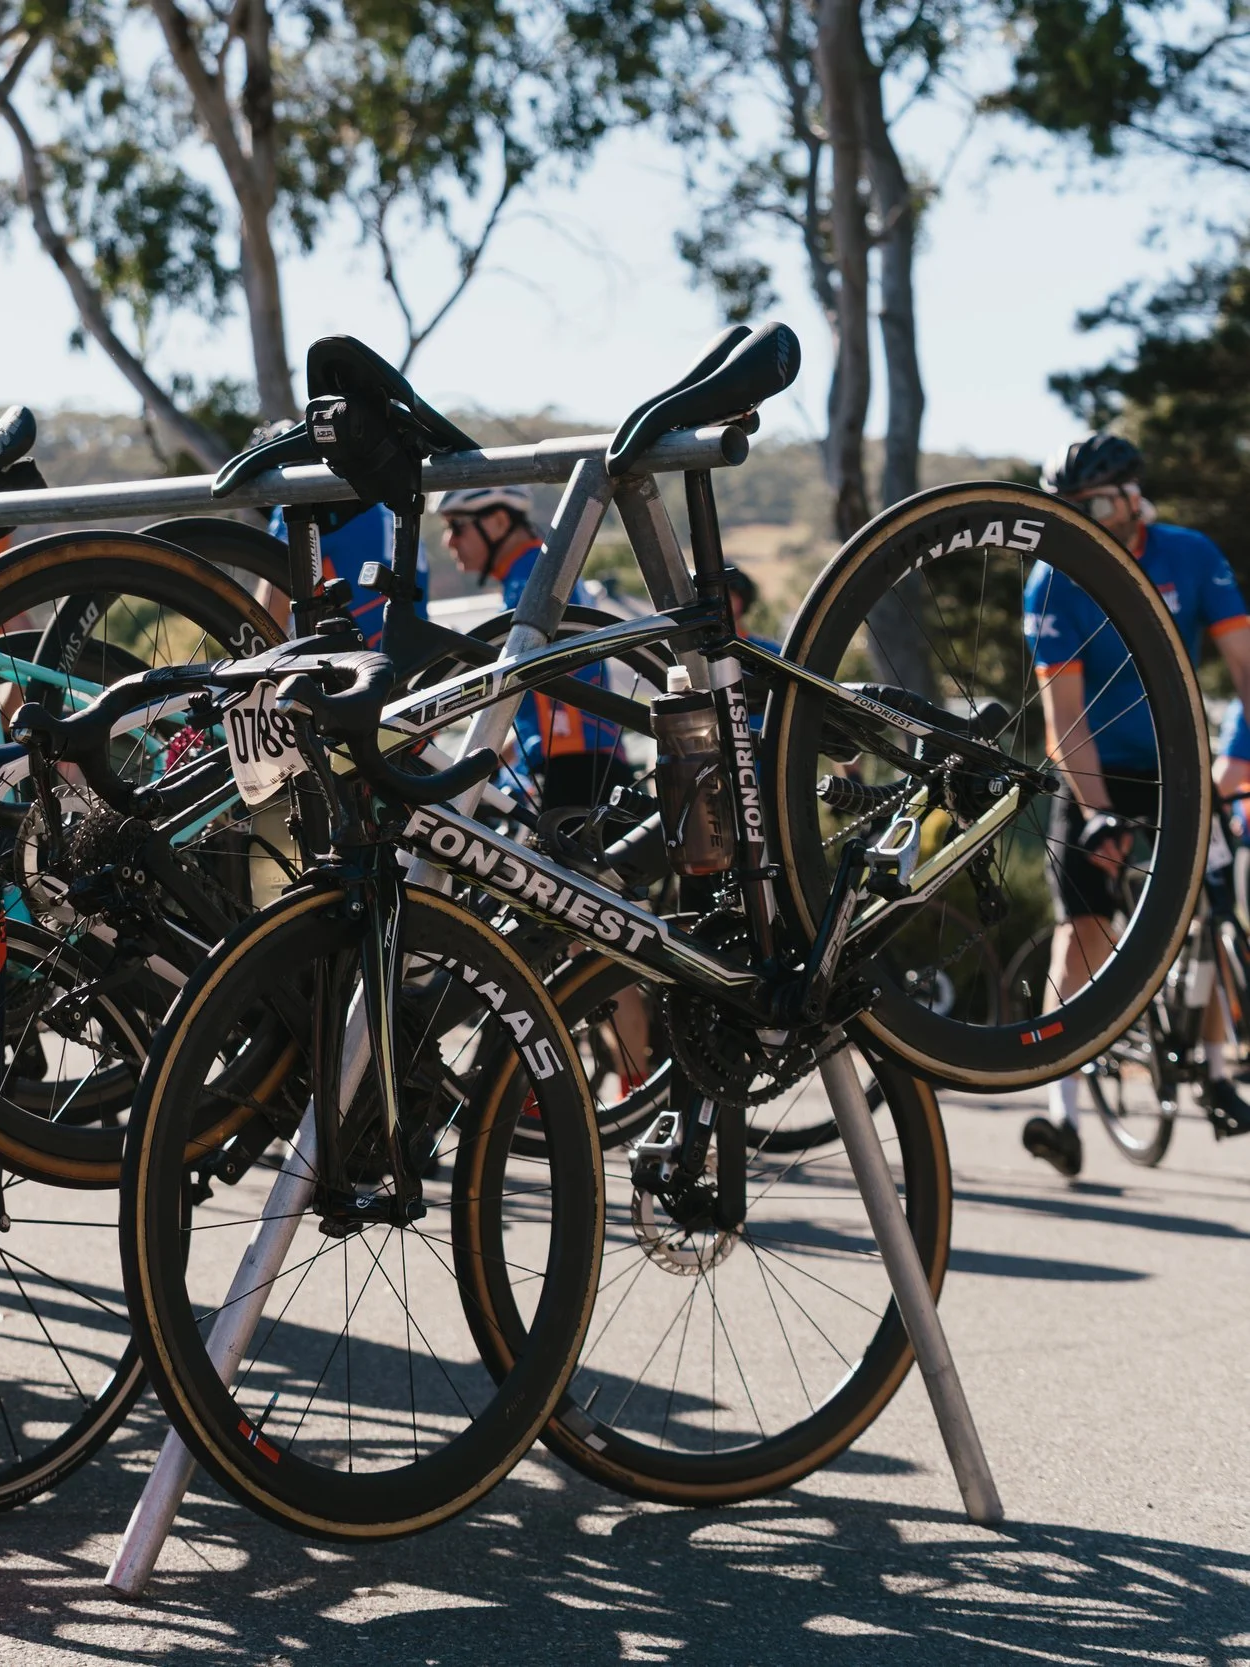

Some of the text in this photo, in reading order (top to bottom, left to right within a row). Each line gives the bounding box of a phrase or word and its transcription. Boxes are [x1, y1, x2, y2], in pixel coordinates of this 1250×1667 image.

[230, 707, 298, 765] 0788
[853, 696, 914, 729] FONDRIEST
[726, 687, 766, 843] FONDRIEST
[402, 810, 656, 953] FONDRIEST
